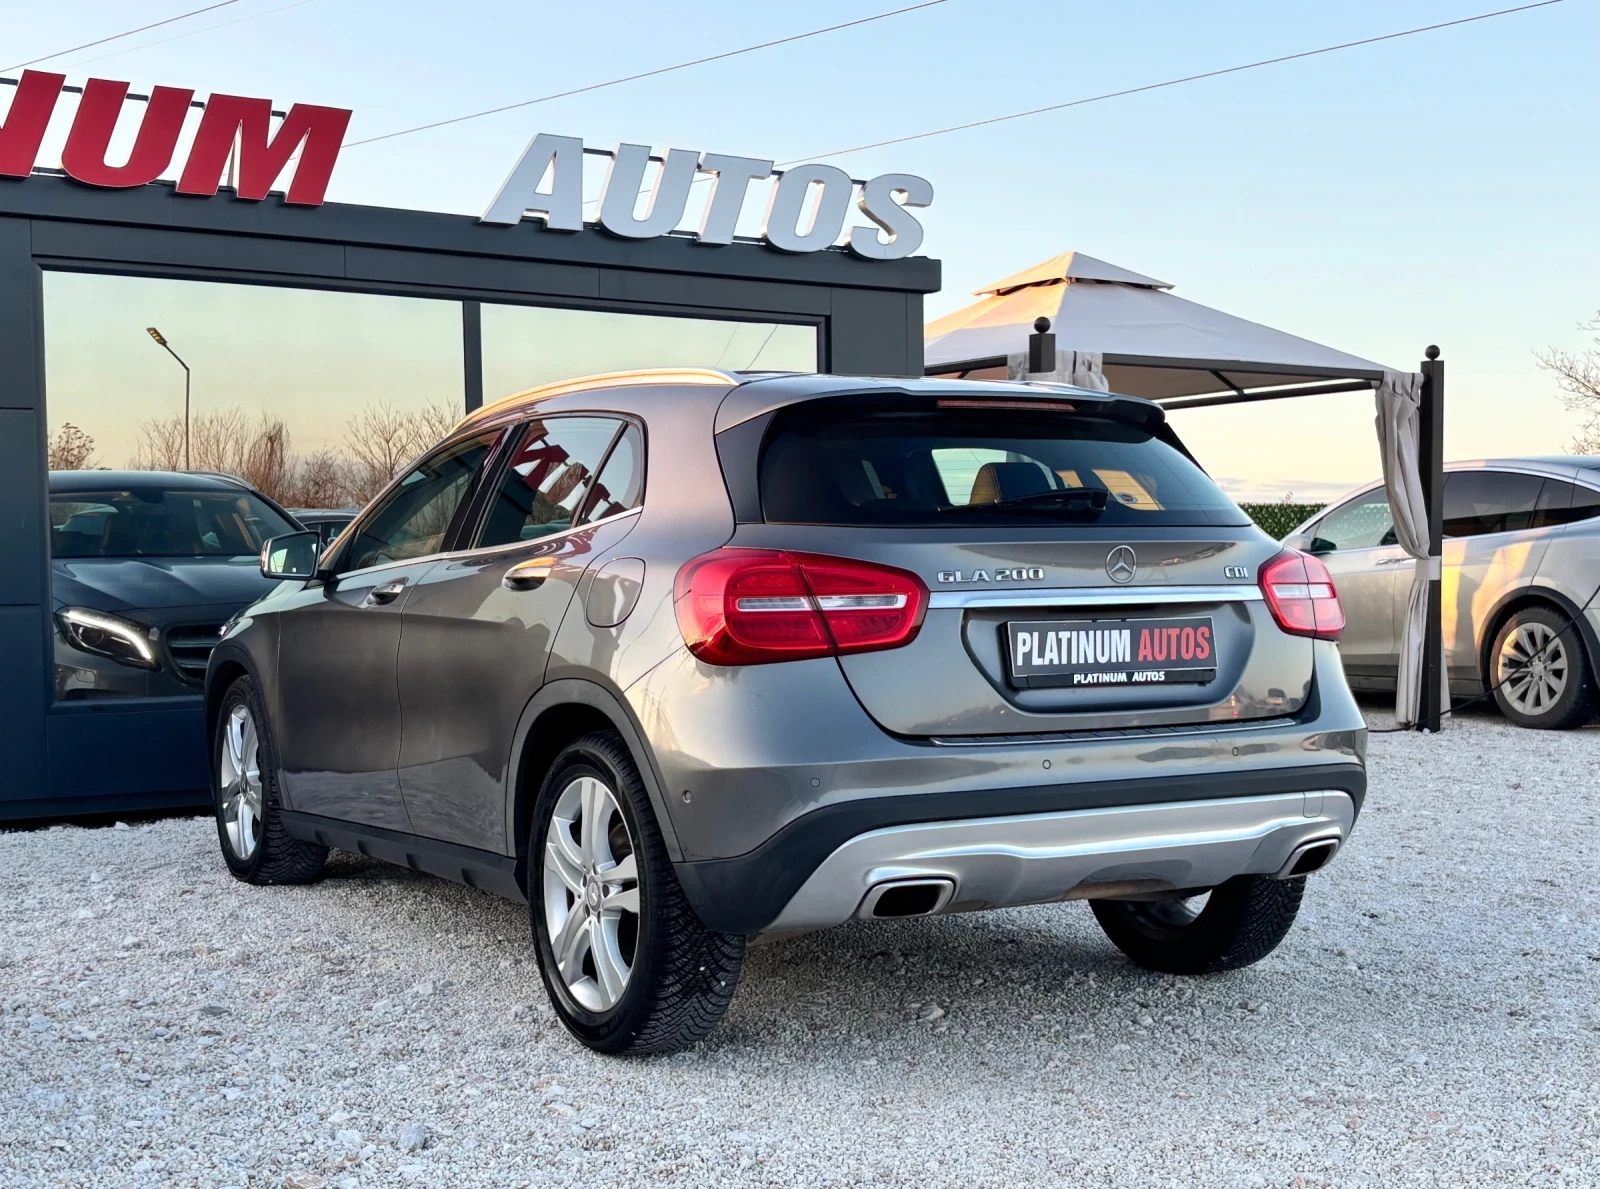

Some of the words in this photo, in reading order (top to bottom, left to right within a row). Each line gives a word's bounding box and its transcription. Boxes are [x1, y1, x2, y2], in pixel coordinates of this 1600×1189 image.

[479, 133, 934, 260] AUTOS
[937, 569, 991, 583] GLA
[995, 567, 1045, 582] 200
[1223, 565, 1249, 579] CDI
[1016, 629, 1131, 666] PLATINUM
[1138, 626, 1211, 662] AUTOS
[1073, 672, 1128, 684] PLATINUM
[1131, 671, 1166, 682] AUTOS
